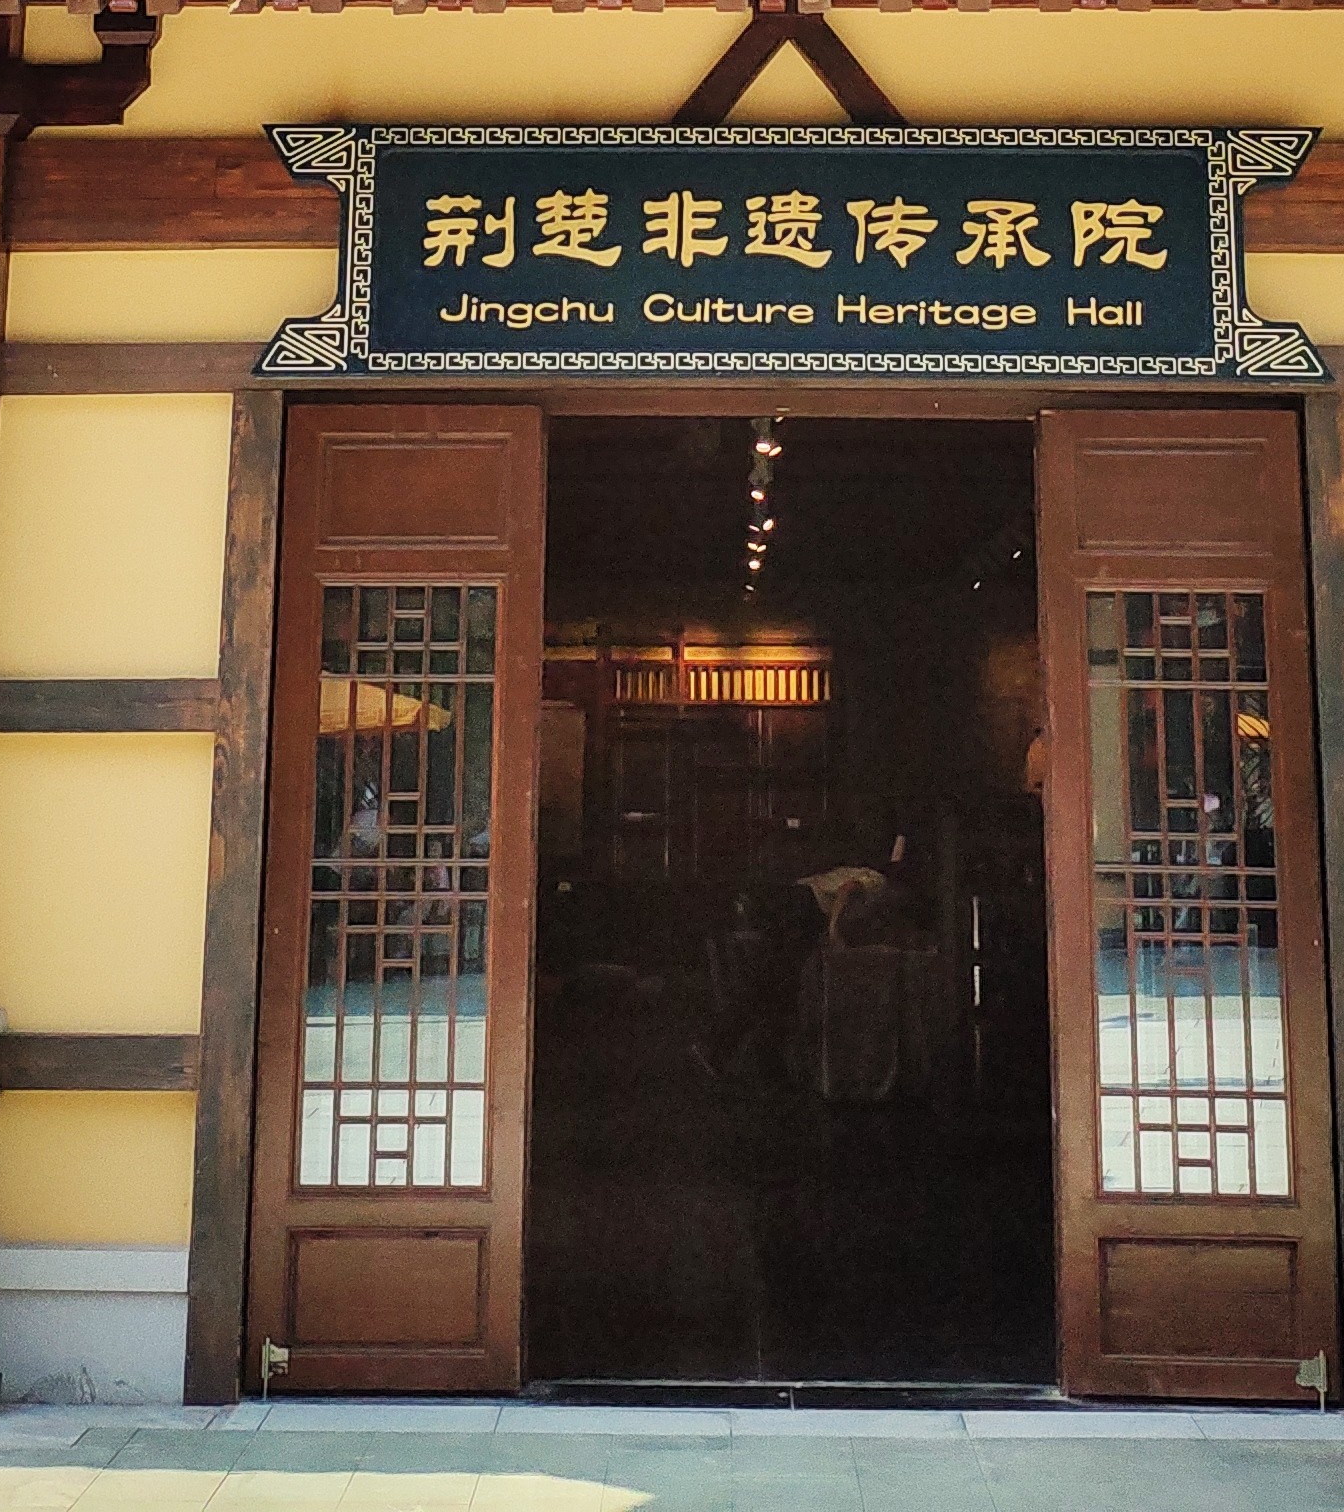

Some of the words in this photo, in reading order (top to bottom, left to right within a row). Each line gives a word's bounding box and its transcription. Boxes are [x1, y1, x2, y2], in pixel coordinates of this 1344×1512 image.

[423, 188, 1168, 270] 荆楚非遗传承院
[440, 294, 614, 329] Jingchu
[643, 292, 814, 324] Culture
[837, 294, 1037, 330] Heritage
[1067, 298, 1142, 326] Hall
